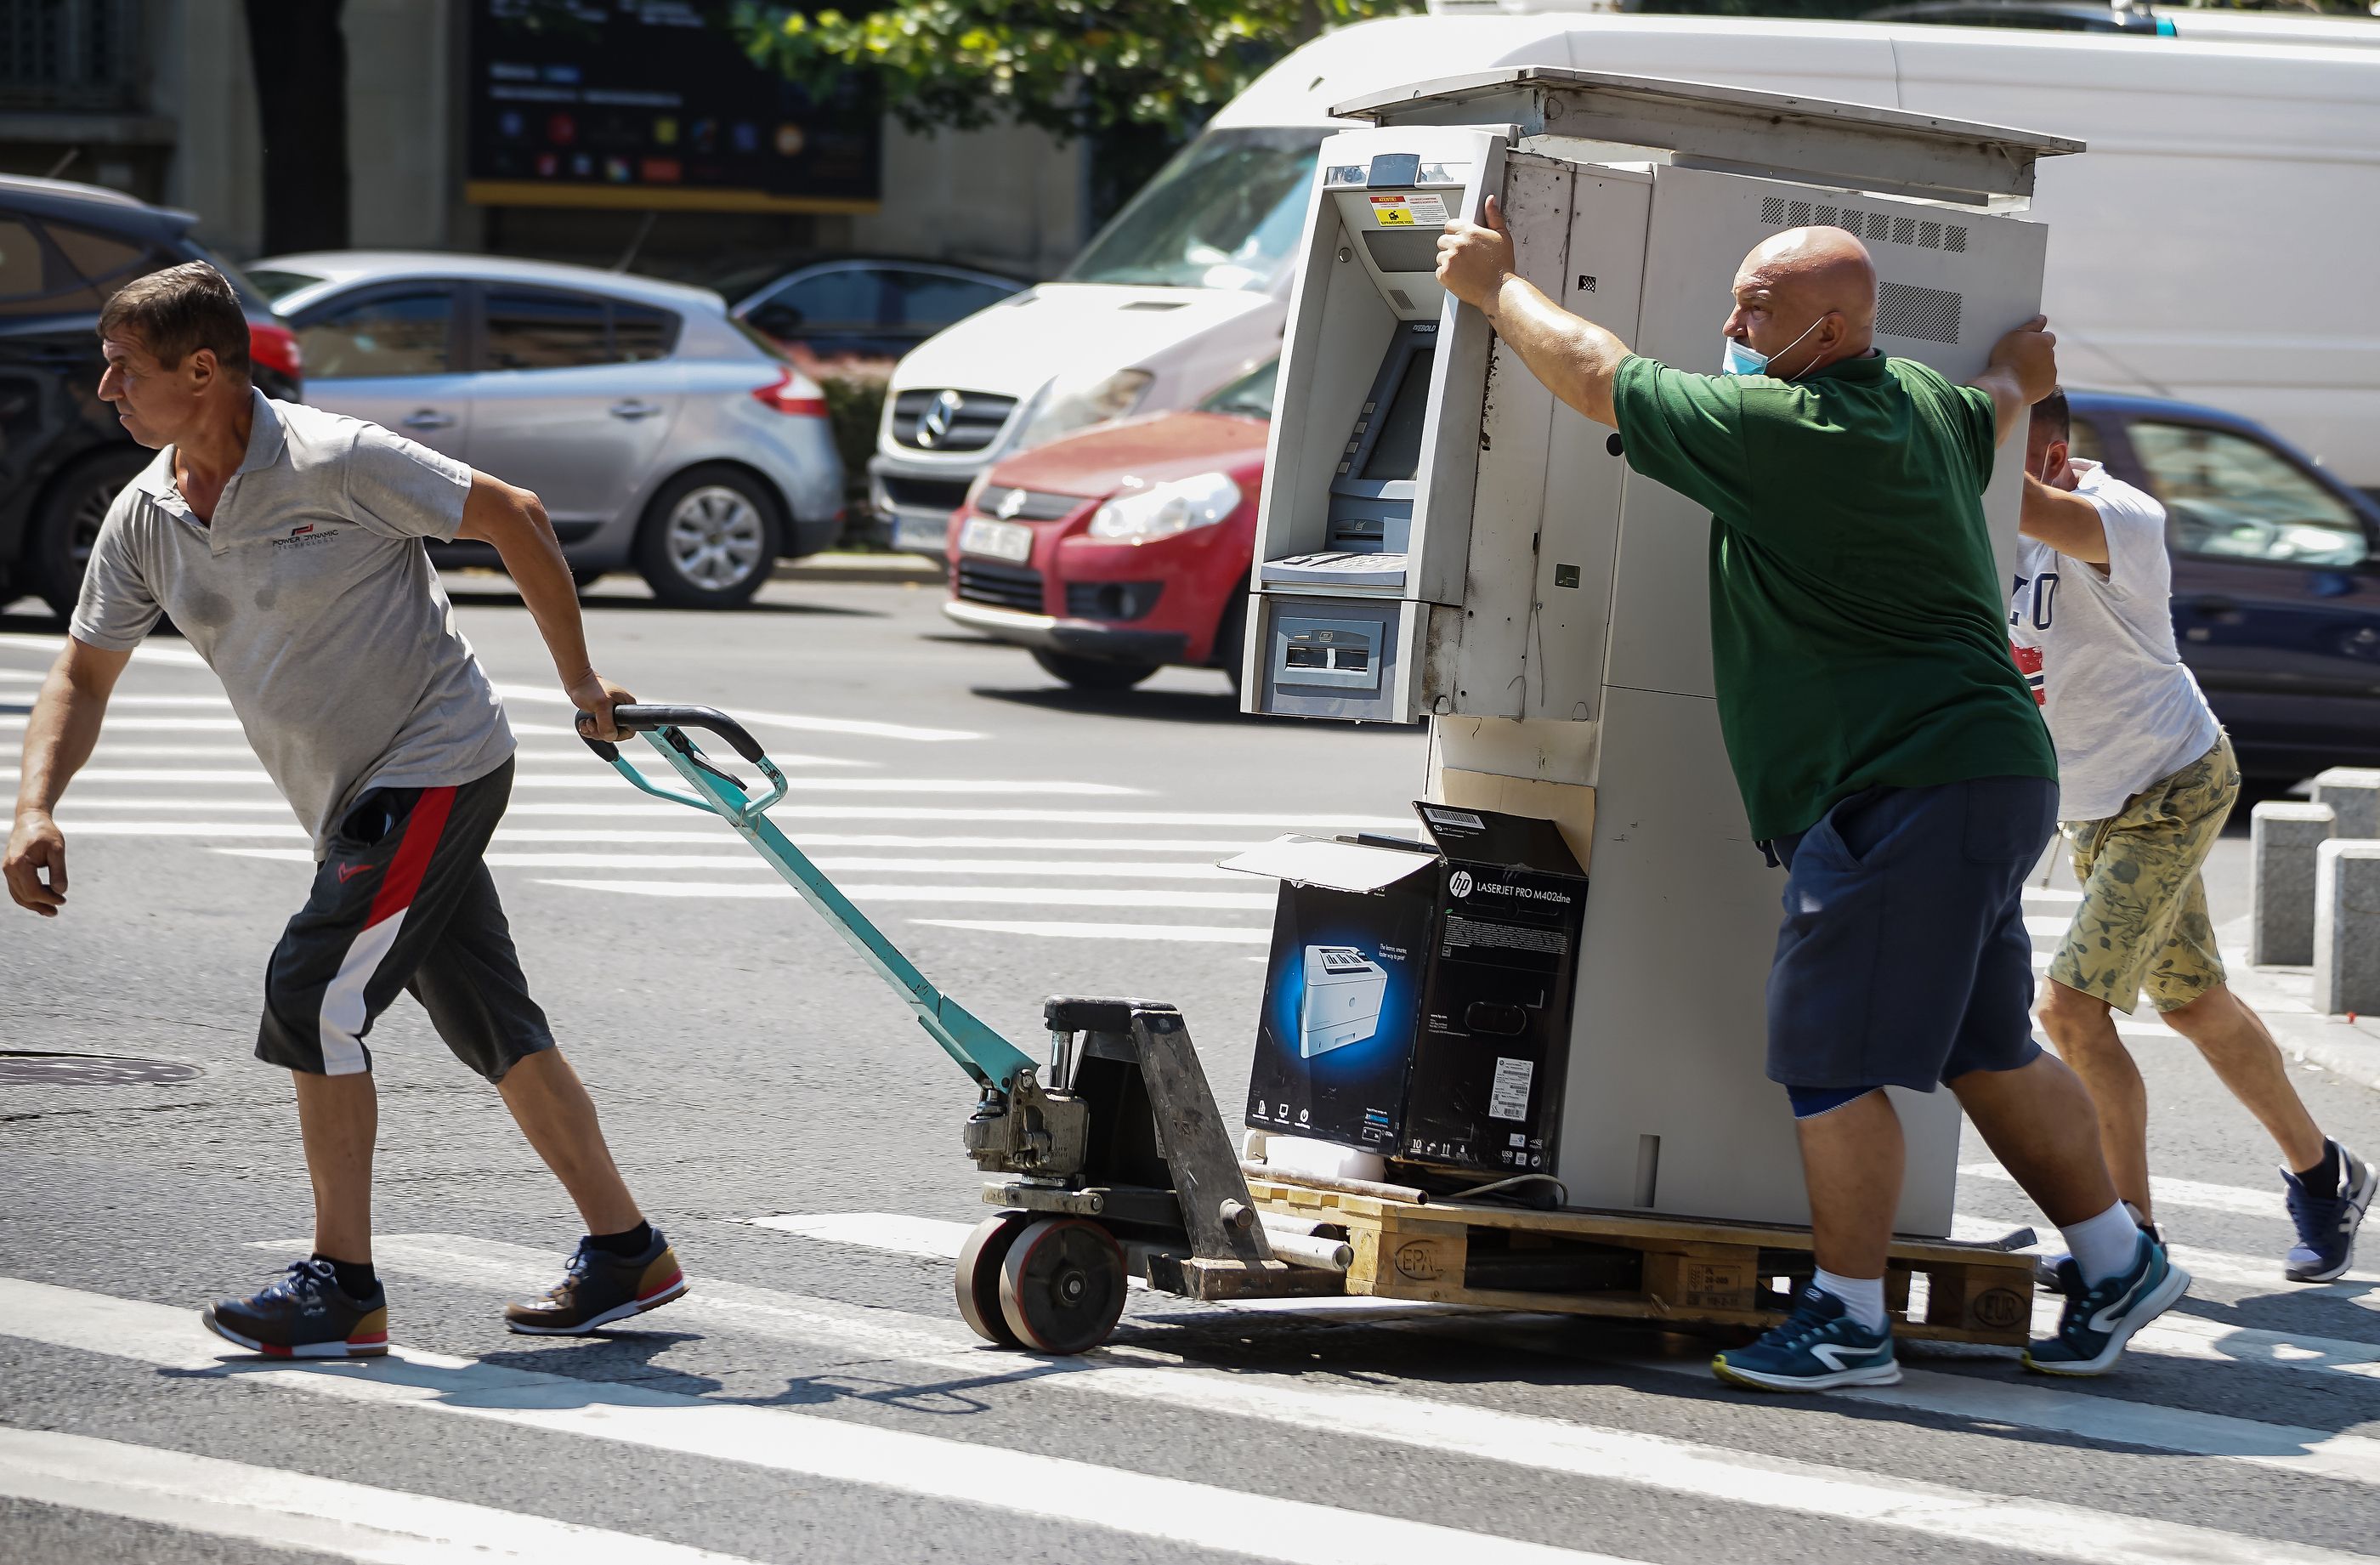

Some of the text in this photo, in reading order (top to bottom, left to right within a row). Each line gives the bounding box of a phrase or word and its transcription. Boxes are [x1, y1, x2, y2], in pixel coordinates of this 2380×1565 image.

[272, 529, 339, 547] POWER DYNAMIC
[278, 537, 334, 551] TECHNOLOGY
[1449, 870, 1572, 904] hp LASERJET PRO M402dne
[1412, 1138, 1422, 1149] 10
[1984, 1295, 2017, 1321] EUR
